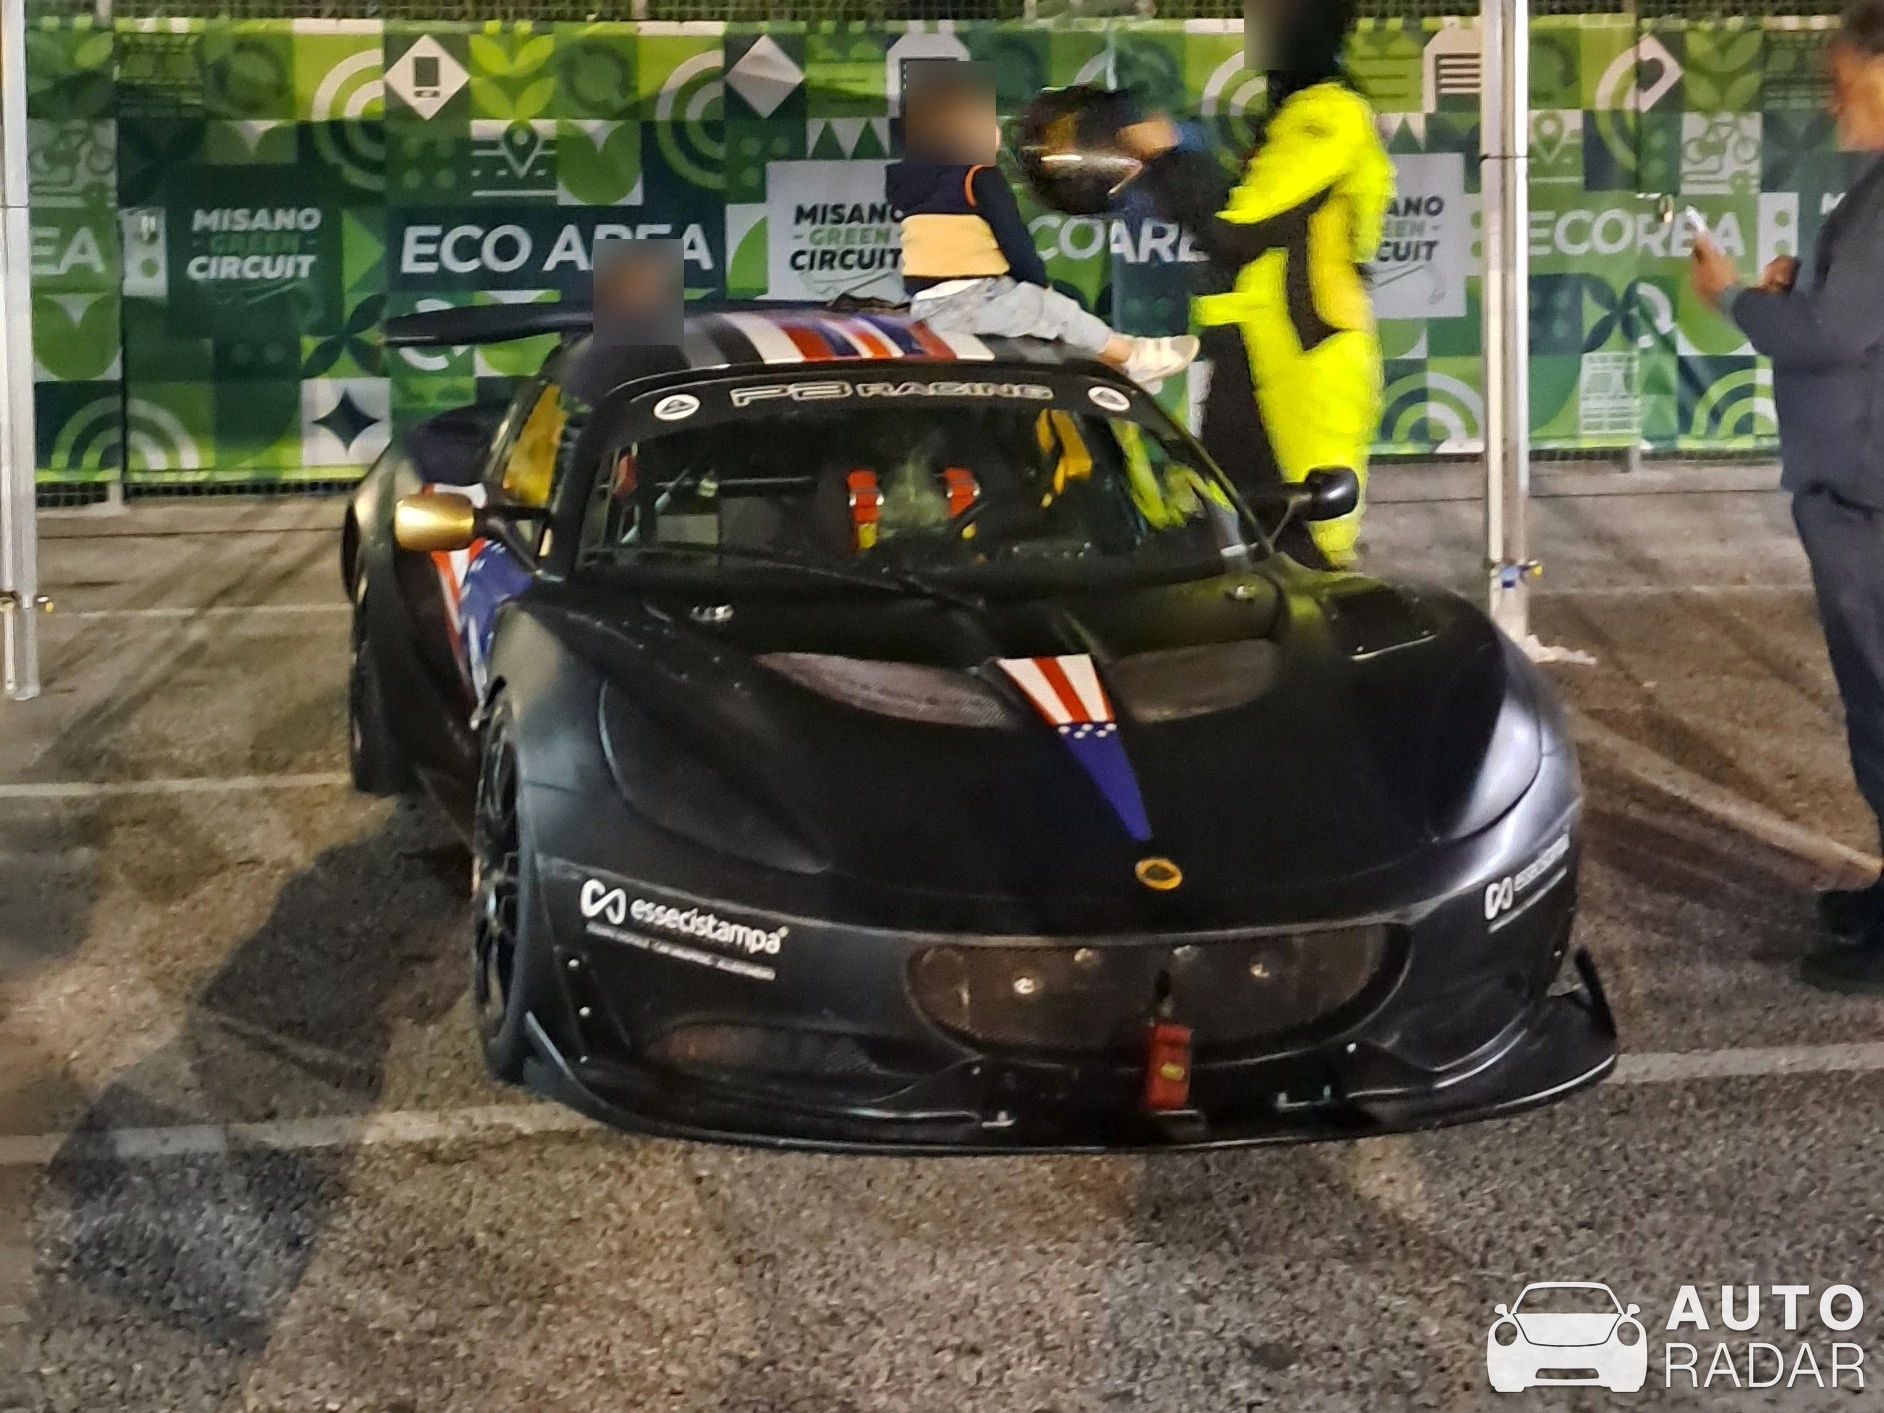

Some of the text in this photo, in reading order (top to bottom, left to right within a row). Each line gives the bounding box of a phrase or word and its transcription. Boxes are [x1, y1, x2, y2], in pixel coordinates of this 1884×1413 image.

[1384, 195, 1444, 217] ANO
[192, 207, 321, 232] MISANO
[809, 227, 891, 246] GREEN
[401, 224, 533, 273] ECO
[789, 247, 903, 271] CIRCUIT
[1377, 239, 1440, 261] CUIT
[187, 254, 318, 280] CIRCUIT
[856, 380, 1054, 400] RACING
